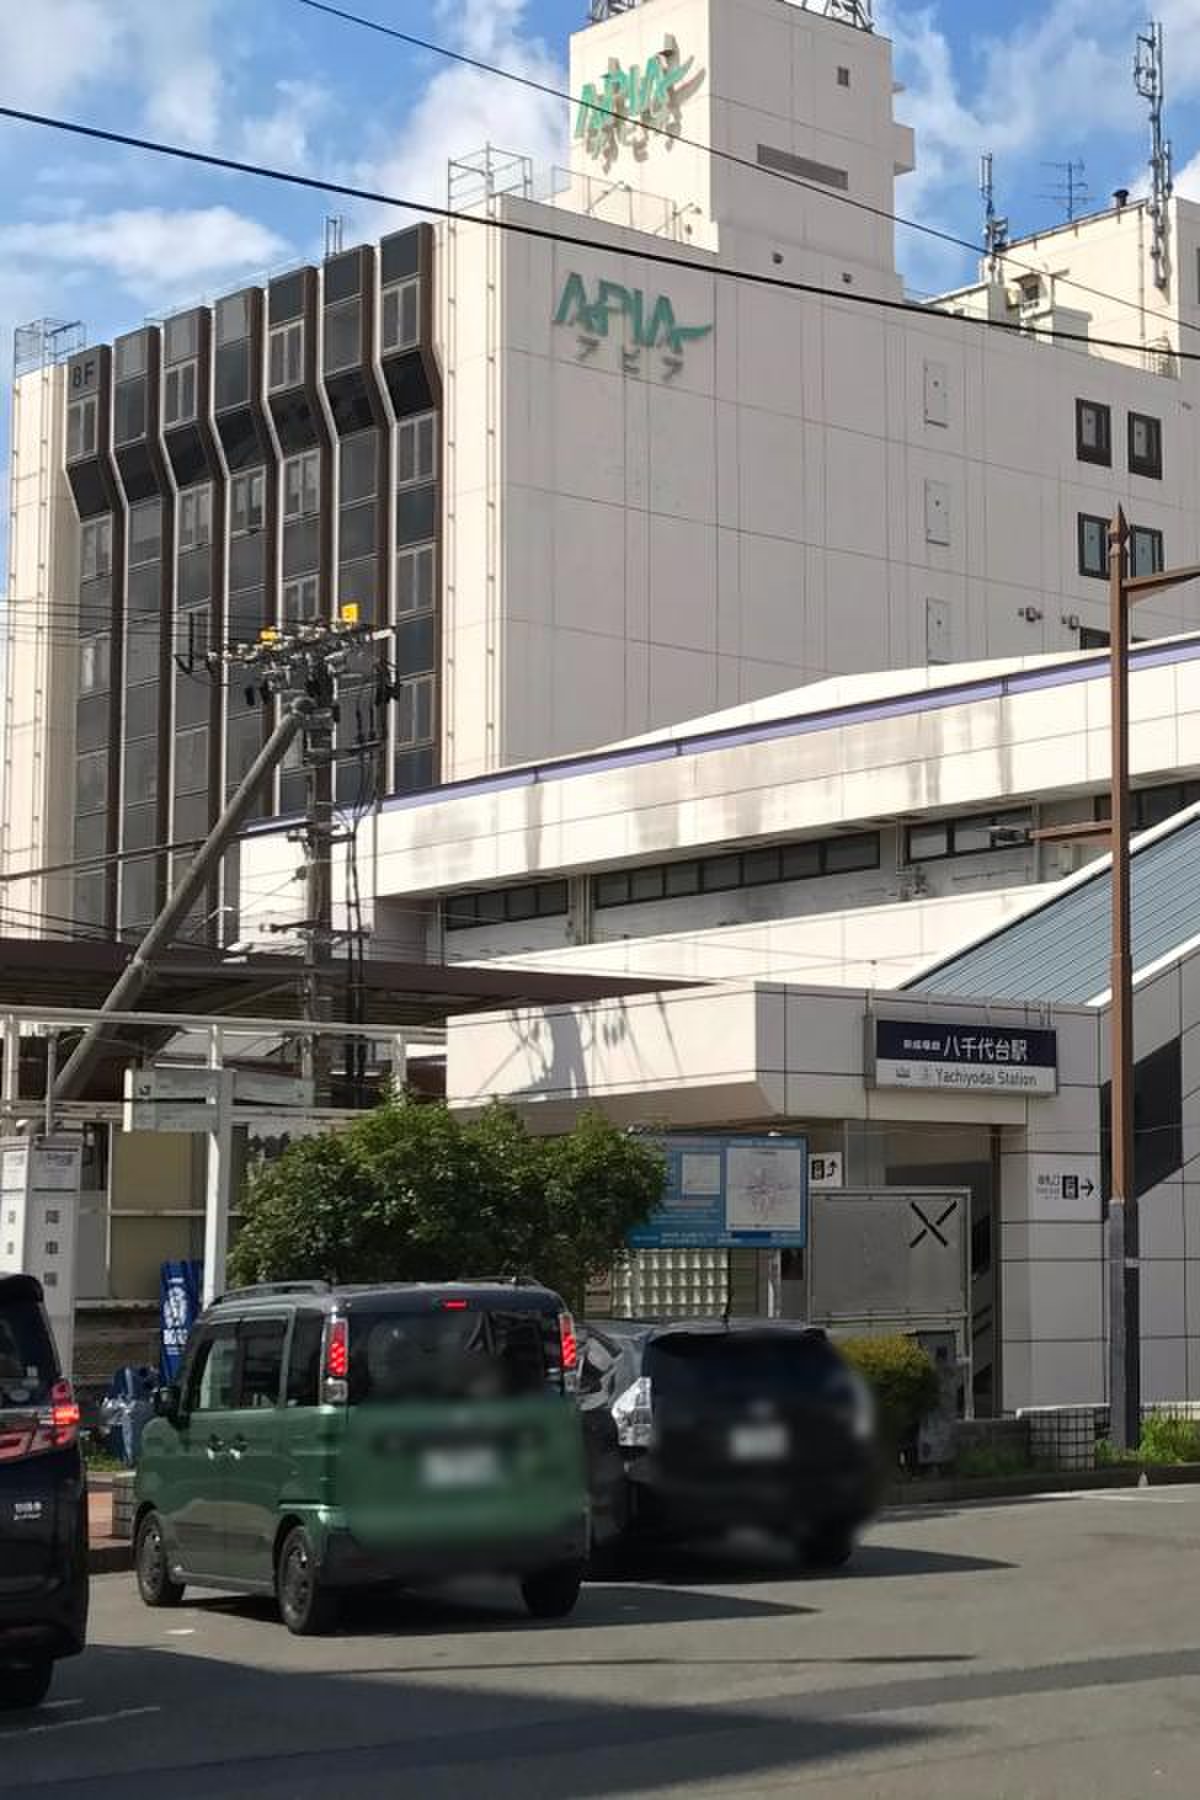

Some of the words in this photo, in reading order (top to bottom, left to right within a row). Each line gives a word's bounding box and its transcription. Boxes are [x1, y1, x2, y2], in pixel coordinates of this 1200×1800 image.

[574, 55, 696, 139] APIA
[552, 271, 713, 354] APIA
[575, 335, 684, 384] アピア
[944, 1034, 1028, 1062] 八千代台駅
[935, 1066, 996, 1087] Yachiyodai
[998, 1070, 1037, 1087] Station
